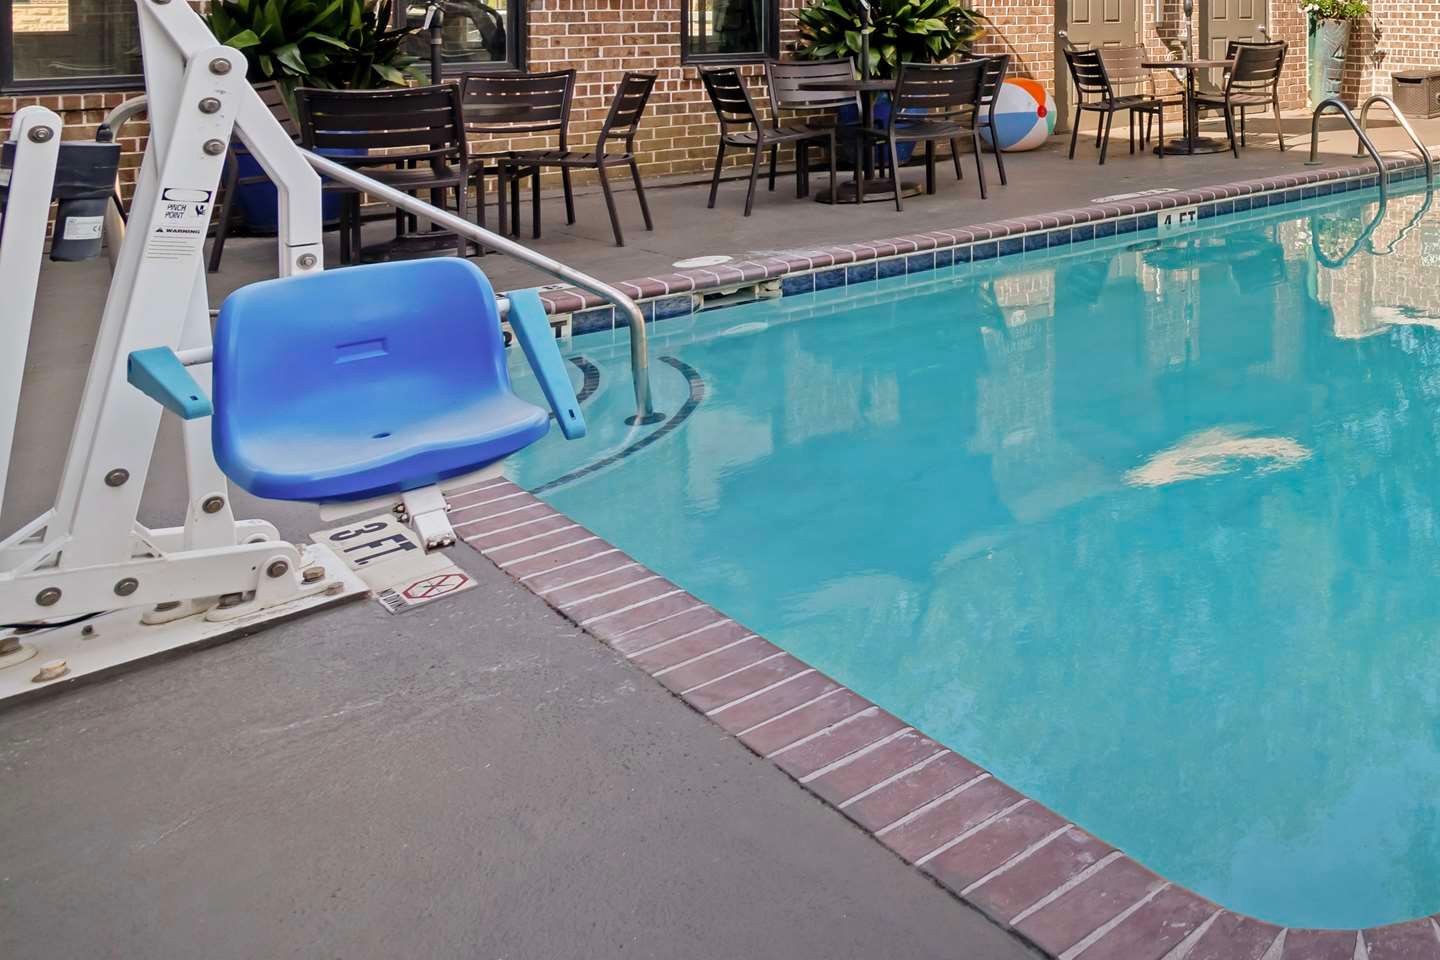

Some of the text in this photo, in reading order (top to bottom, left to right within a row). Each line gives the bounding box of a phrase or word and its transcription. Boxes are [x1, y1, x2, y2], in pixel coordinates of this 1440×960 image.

[167, 203, 187, 211] PINCH
[164, 211, 184, 219] POINT
[1179, 210, 1196, 223] FT
[329, 522, 388, 541] 3
